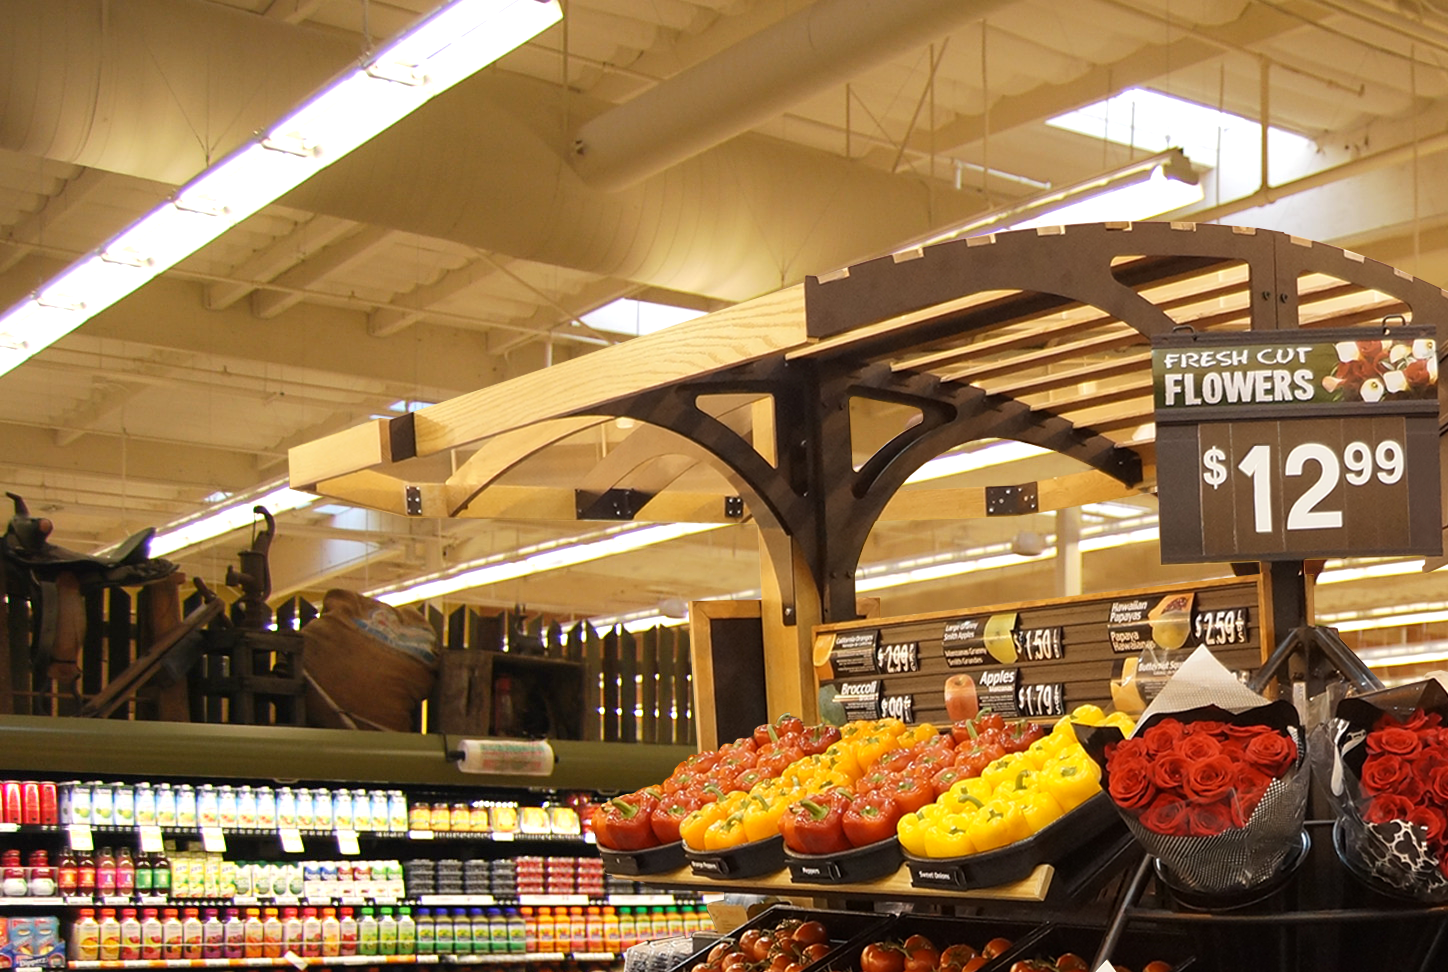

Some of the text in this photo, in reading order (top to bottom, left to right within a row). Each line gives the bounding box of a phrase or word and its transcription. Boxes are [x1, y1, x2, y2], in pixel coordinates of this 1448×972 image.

[1164, 347, 1312, 369] FRESH CUT
[1164, 369, 1315, 406] FLOWERS
[1112, 600, 1148, 612] Hawaiian
[1110, 611, 1142, 623] Papayas
[1110, 631, 1139, 643] Papaya
[979, 669, 1015, 686] Apples
[841, 680, 877, 695] Broccoli
